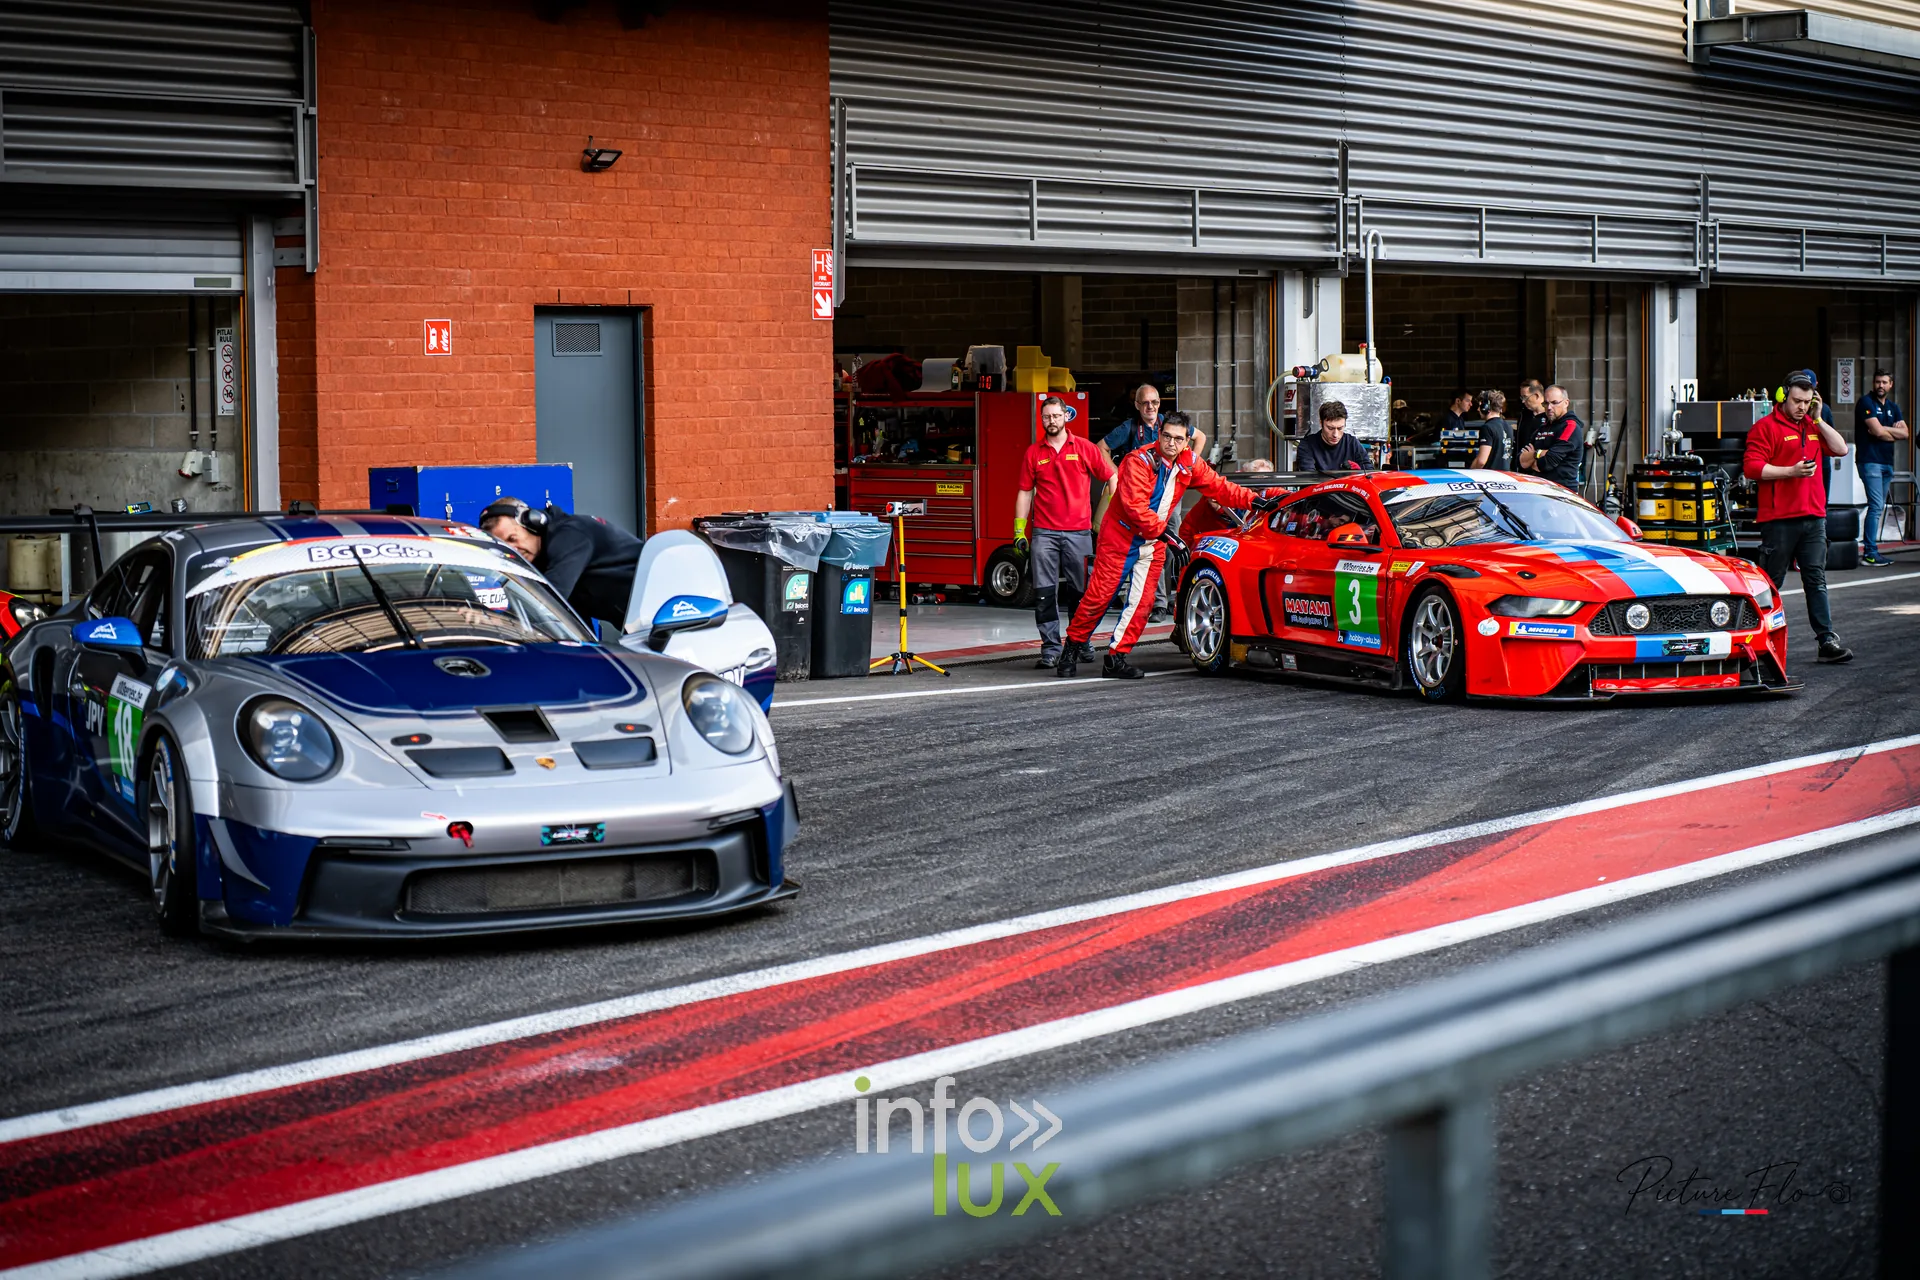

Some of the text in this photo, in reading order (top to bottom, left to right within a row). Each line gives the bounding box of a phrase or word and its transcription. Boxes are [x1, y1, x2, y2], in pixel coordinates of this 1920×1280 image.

[814, 254, 825, 272] H
[1683, 383, 1695, 402] 12
[1447, 481, 1518, 491] BGDC.be
[309, 543, 433, 562] BGDC.be
[1212, 540, 1237, 556] ELEK
[1342, 562, 1375, 573] 100series.be
[1198, 569, 1222, 584] MICHELIN
[489, 593, 507, 604] CUP
[1285, 597, 1331, 617] MAYAMI
[1348, 579, 1362, 625] 3
[1528, 626, 1568, 634] MICHELIN
[1348, 634, 1381, 646] hobby-alu.be
[85, 699, 105, 737] JPV
[114, 701, 135, 782] 18
